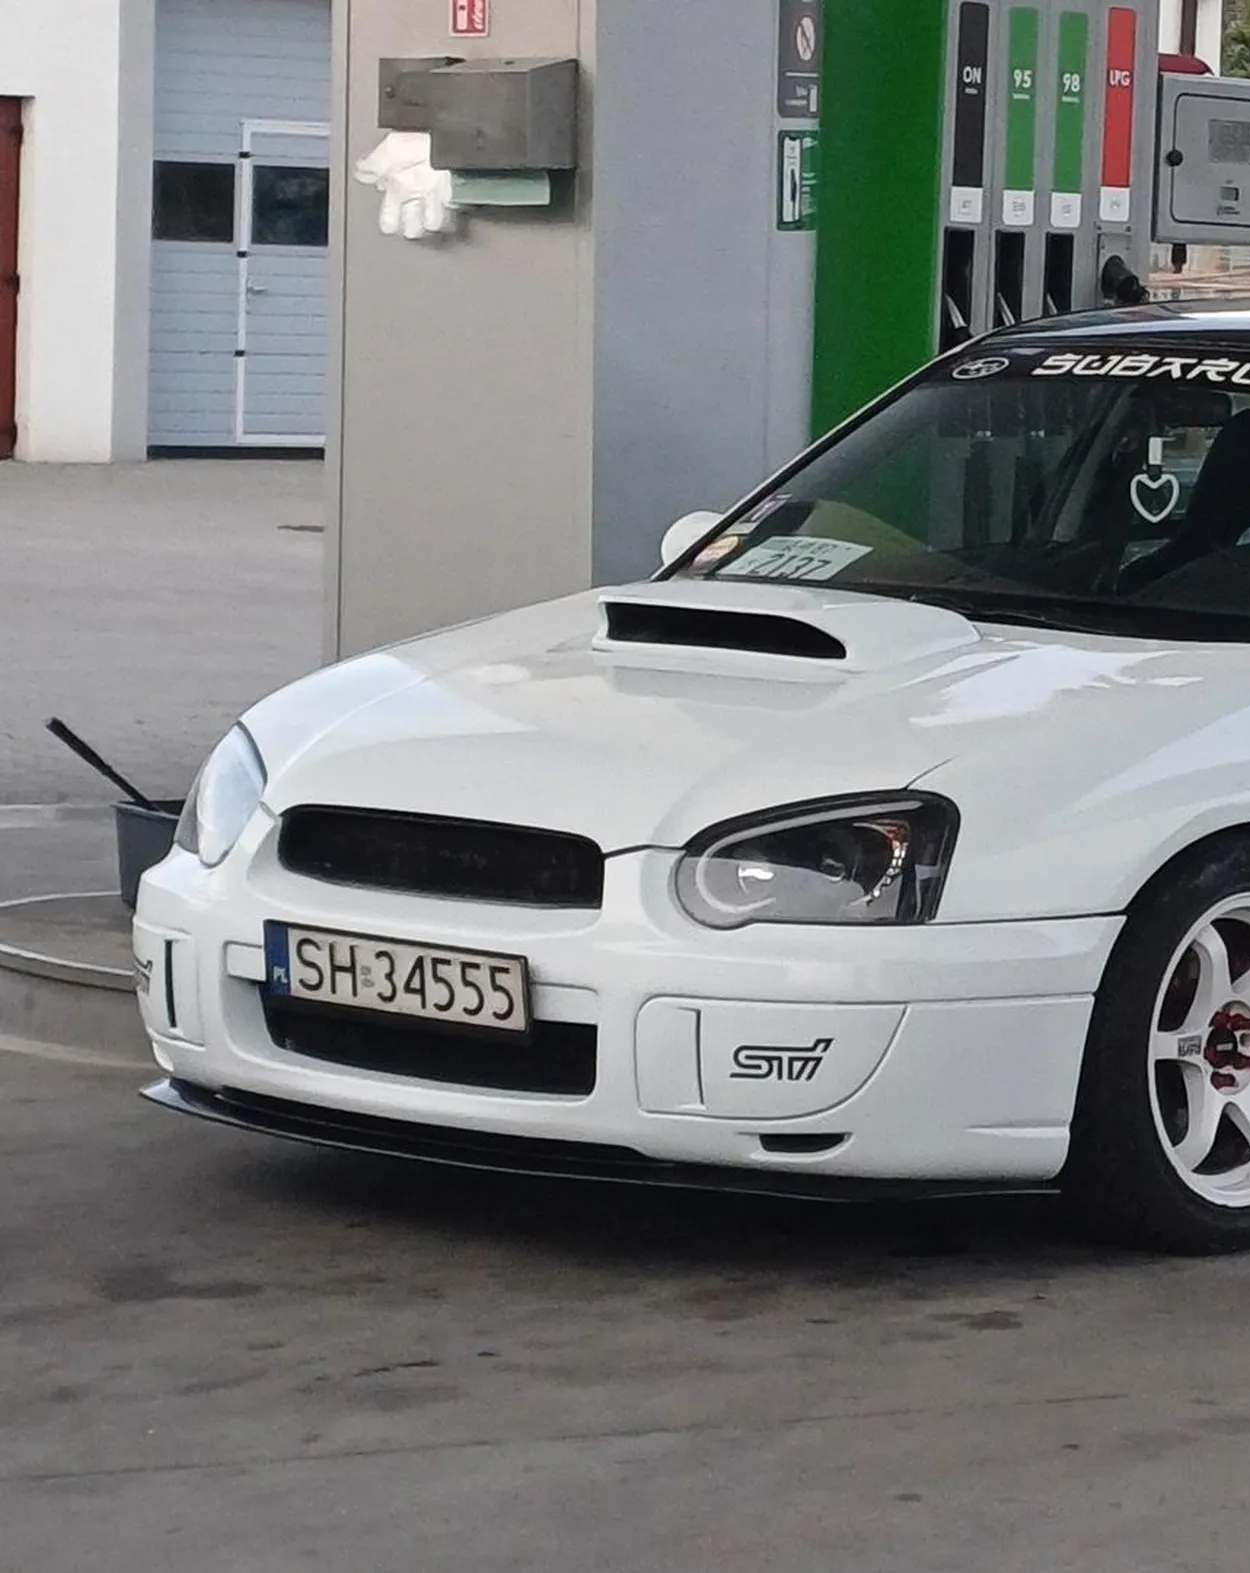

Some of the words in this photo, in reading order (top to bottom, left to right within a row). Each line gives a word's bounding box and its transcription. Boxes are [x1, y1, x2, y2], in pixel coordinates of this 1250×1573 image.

[963, 66, 982, 84] ON
[1013, 69, 1032, 88] 95
[1063, 73, 1081, 93] 98
[1109, 69, 1131, 87] LPG
[273, 966, 288, 984] PL
[295, 937, 358, 998] SH
[374, 950, 515, 1021] 34555
